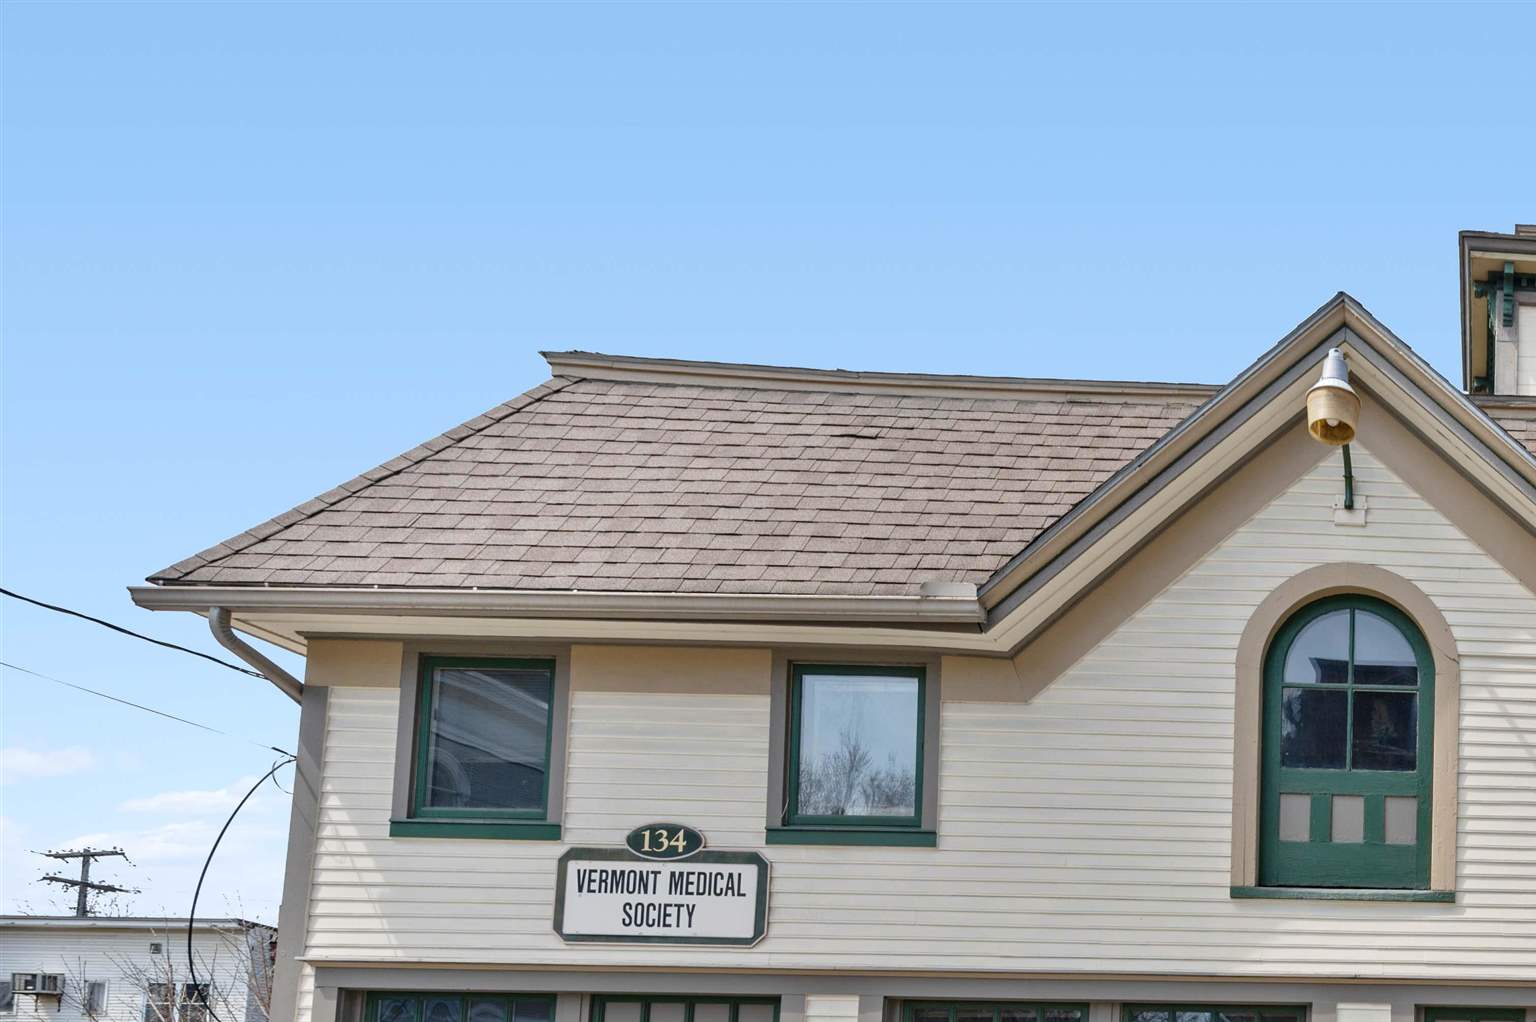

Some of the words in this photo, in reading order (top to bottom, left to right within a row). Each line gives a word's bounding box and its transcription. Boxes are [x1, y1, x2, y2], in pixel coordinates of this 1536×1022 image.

[640, 828, 687, 853] 134
[576, 868, 662, 895] VERMONT
[668, 870, 747, 898] MEDICAL
[621, 901, 696, 929] SOCIETY
